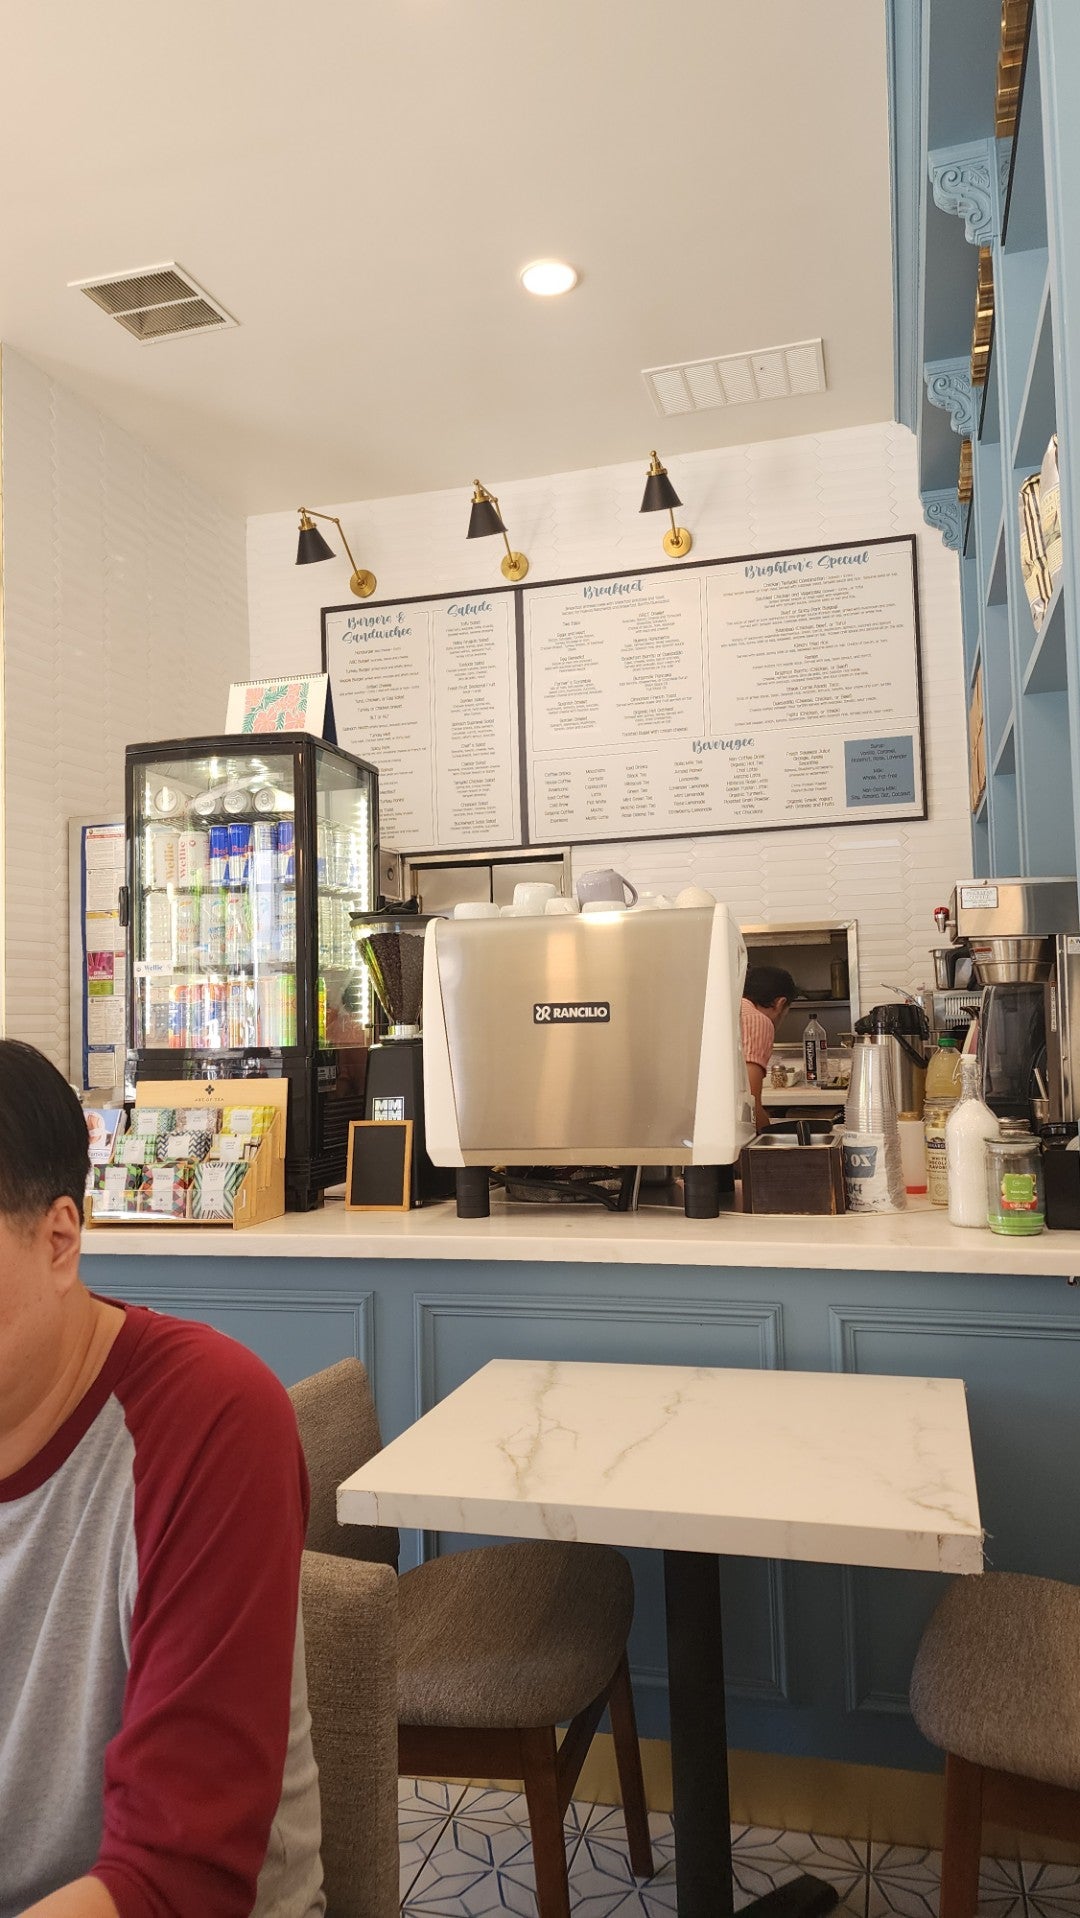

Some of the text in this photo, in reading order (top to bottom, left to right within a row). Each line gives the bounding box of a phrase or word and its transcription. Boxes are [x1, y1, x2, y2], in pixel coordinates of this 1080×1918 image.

[817, 550, 870, 570] Special
[583, 579, 644, 599] Breakfast
[446, 600, 492, 617] Salads
[348, 611, 404, 630] Burgers &
[342, 626, 412, 644] Sandwiches
[692, 738, 754, 754] Beverages
[553, 1006, 608, 1018] RANCILIO
